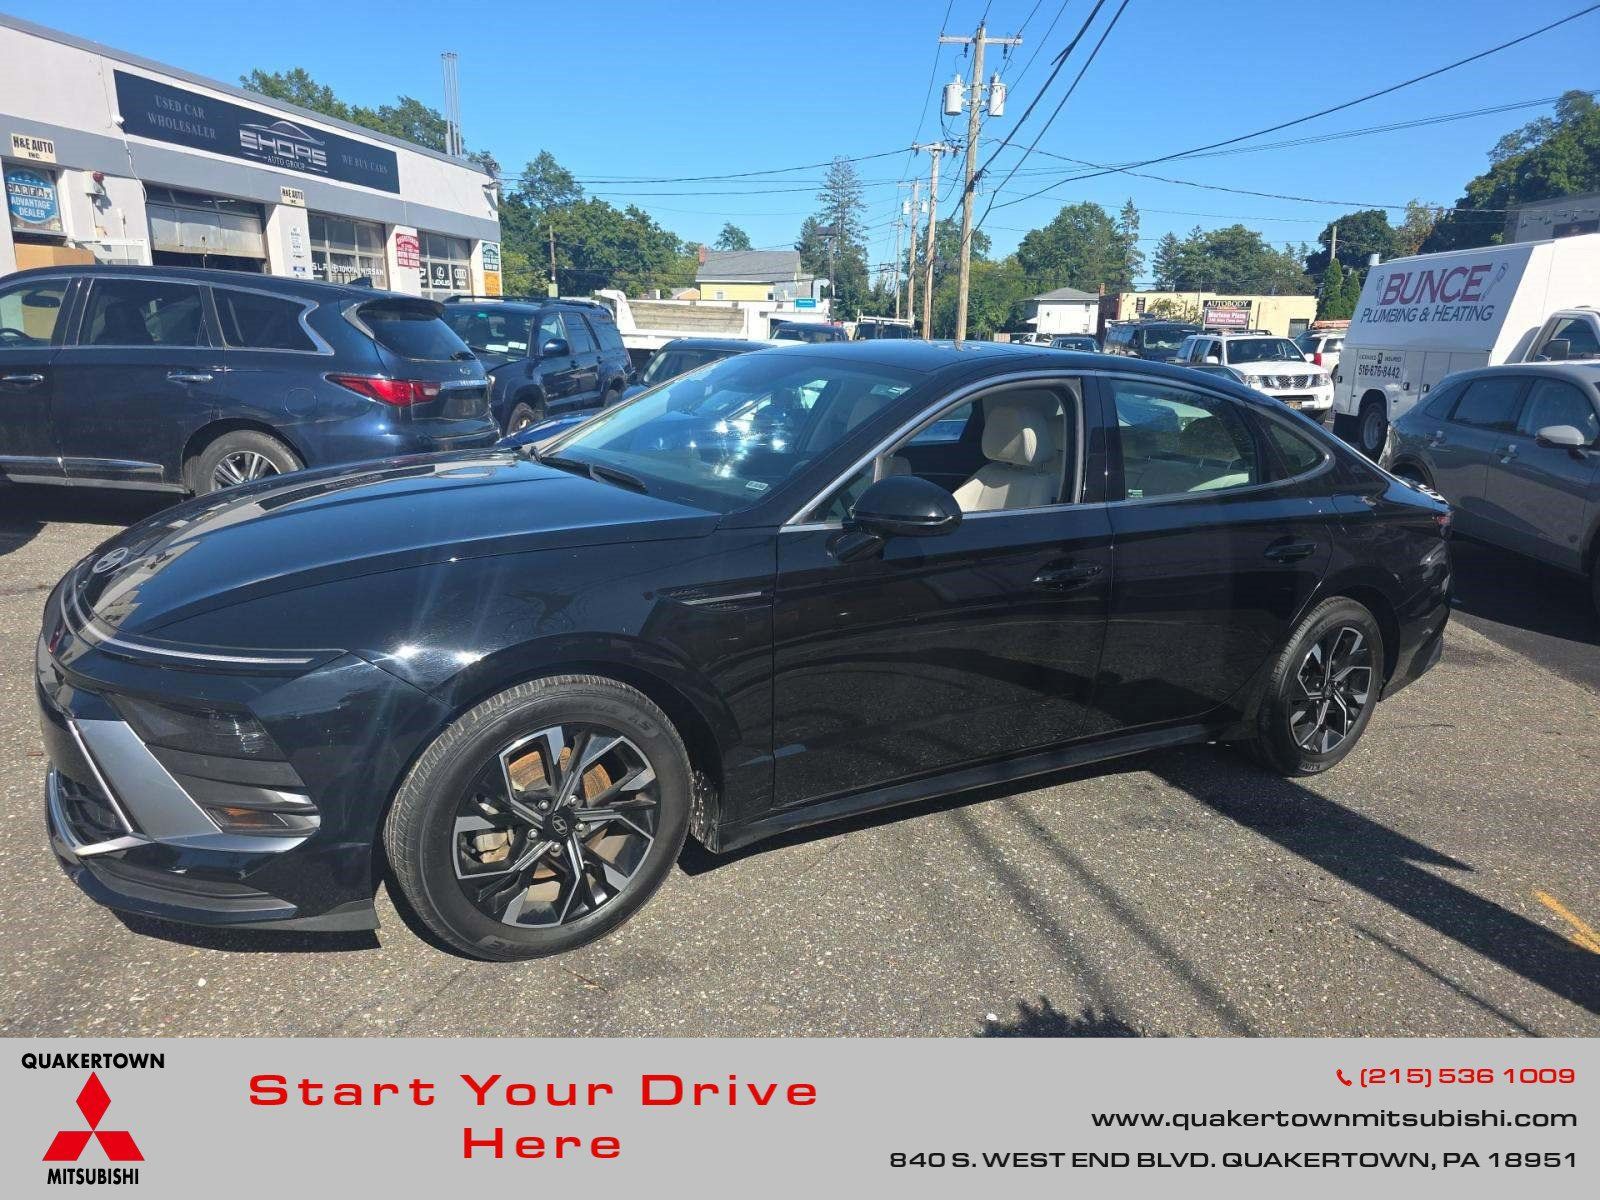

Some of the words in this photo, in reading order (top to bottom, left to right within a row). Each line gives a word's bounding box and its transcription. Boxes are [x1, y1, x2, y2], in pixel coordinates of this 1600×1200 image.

[155, 95, 181, 114] USED
[184, 103, 206, 120] CAR
[147, 111, 217, 141] WHOLESALER
[13, 135, 31, 150] H&E
[32, 137, 54, 154] AUTO
[267, 155, 285, 168] AUTO
[285, 158, 306, 171] GROUP
[341, 154, 355, 166] WE
[370, 160, 389, 175] CARS
[7, 182, 53, 201] CARFAX
[292, 189, 304, 200] AUTO
[11, 195, 51, 210] ADVANTAGE
[19, 206, 46, 219] DEALER
[360, 266, 384, 276] NISSAN
[1380, 263, 1493, 306] BUNCE
[1206, 299, 1249, 308] AUTOBODY
[1360, 307, 1417, 324] PLUMBING
[1418, 308, 1431, 322] &
[1431, 304, 1495, 322] HEATING
